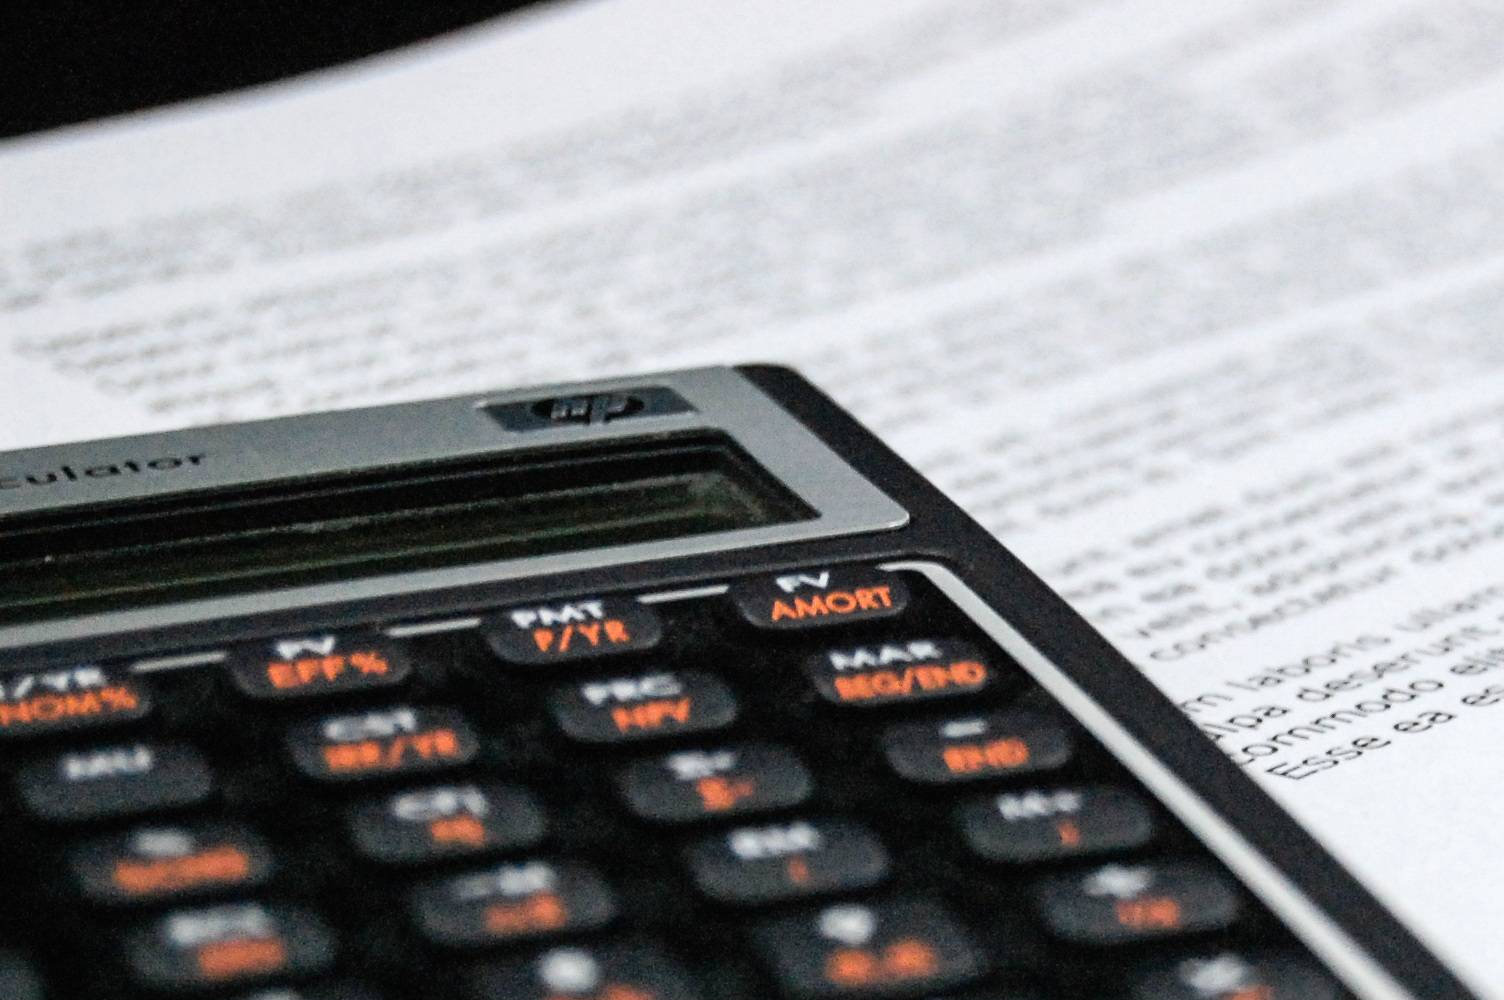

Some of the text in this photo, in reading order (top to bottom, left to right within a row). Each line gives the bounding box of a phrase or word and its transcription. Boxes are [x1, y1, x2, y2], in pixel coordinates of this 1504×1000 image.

[775, 572, 829, 592] FV
[511, 602, 603, 629] PMT
[770, 586, 892, 622] AMORT
[532, 619, 630, 653] P/YR
[829, 641, 941, 671] MAR
[1224, 634, 1393, 692] laboris
[1296, 624, 1502, 702] deserunt
[0, 665, 104, 699] /YR
[1265, 732, 1392, 781] Esse
[1392, 710, 1458, 733] ea
